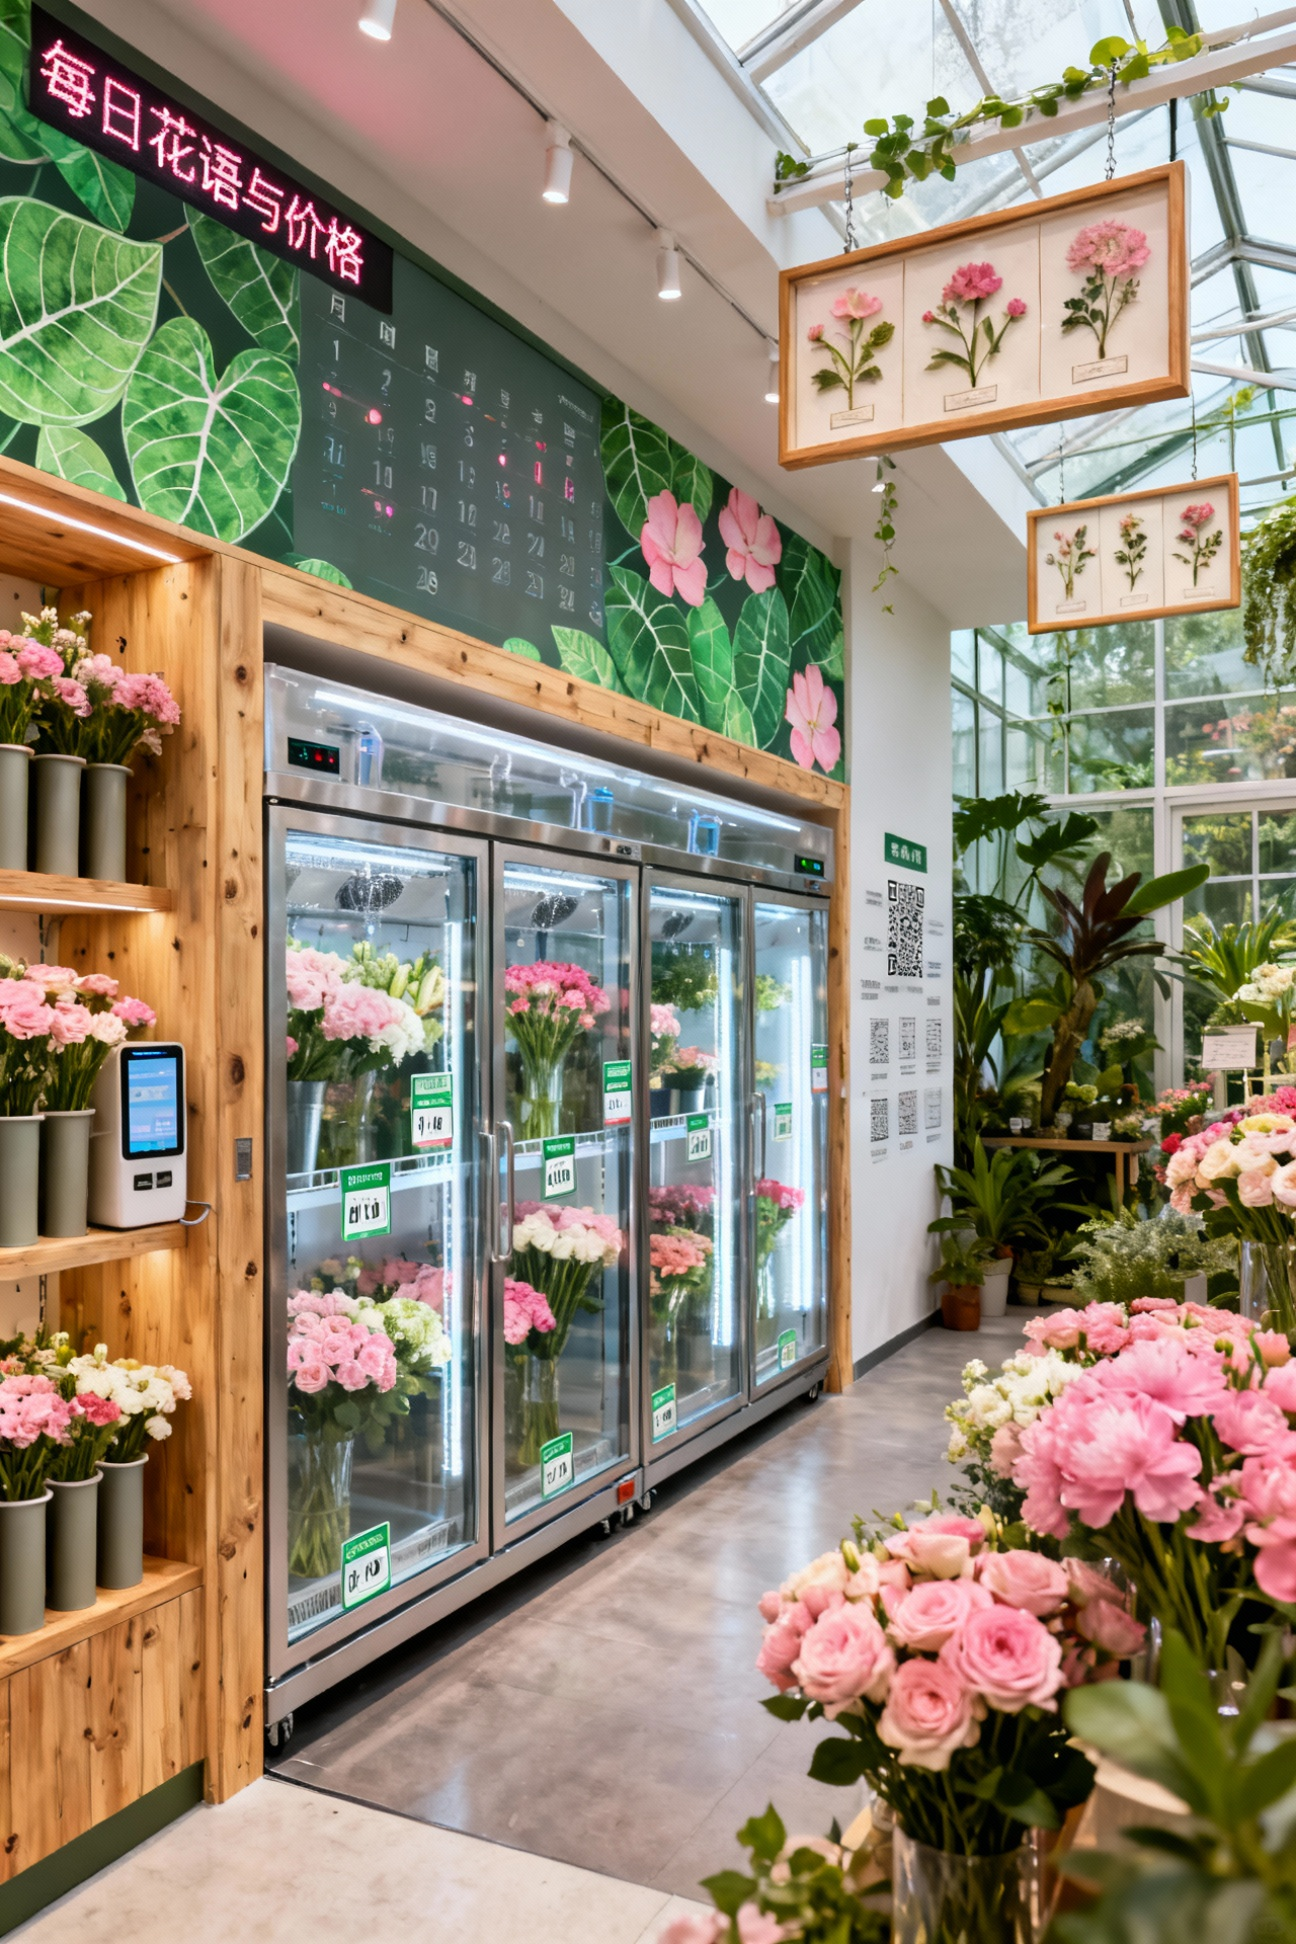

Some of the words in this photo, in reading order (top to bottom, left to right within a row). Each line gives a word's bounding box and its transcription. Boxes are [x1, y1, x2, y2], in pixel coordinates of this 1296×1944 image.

[40, 40, 365, 285] 每日花语与价格
